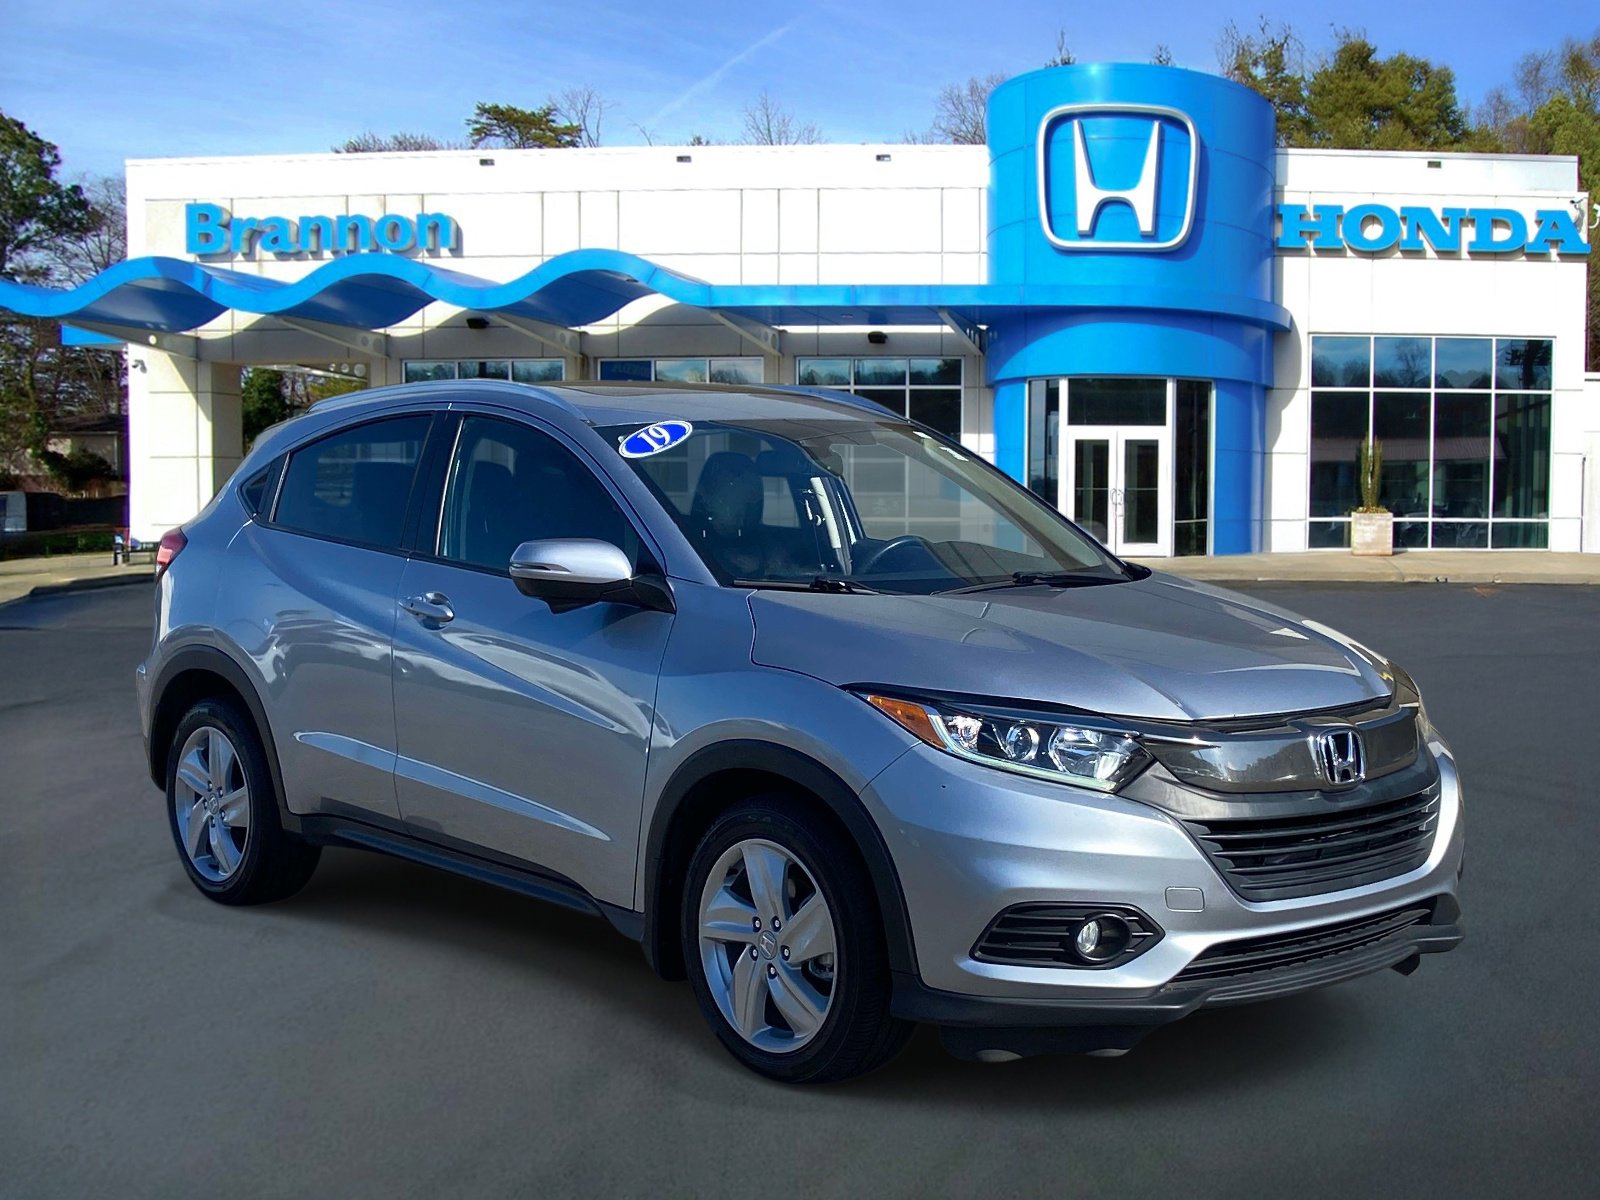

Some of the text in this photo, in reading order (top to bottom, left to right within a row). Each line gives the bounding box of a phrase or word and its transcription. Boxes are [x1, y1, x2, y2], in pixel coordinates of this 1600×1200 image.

[185, 202, 456, 254] Brannon
[1276, 203, 1591, 254] HONDA
[637, 426, 671, 452] 19
